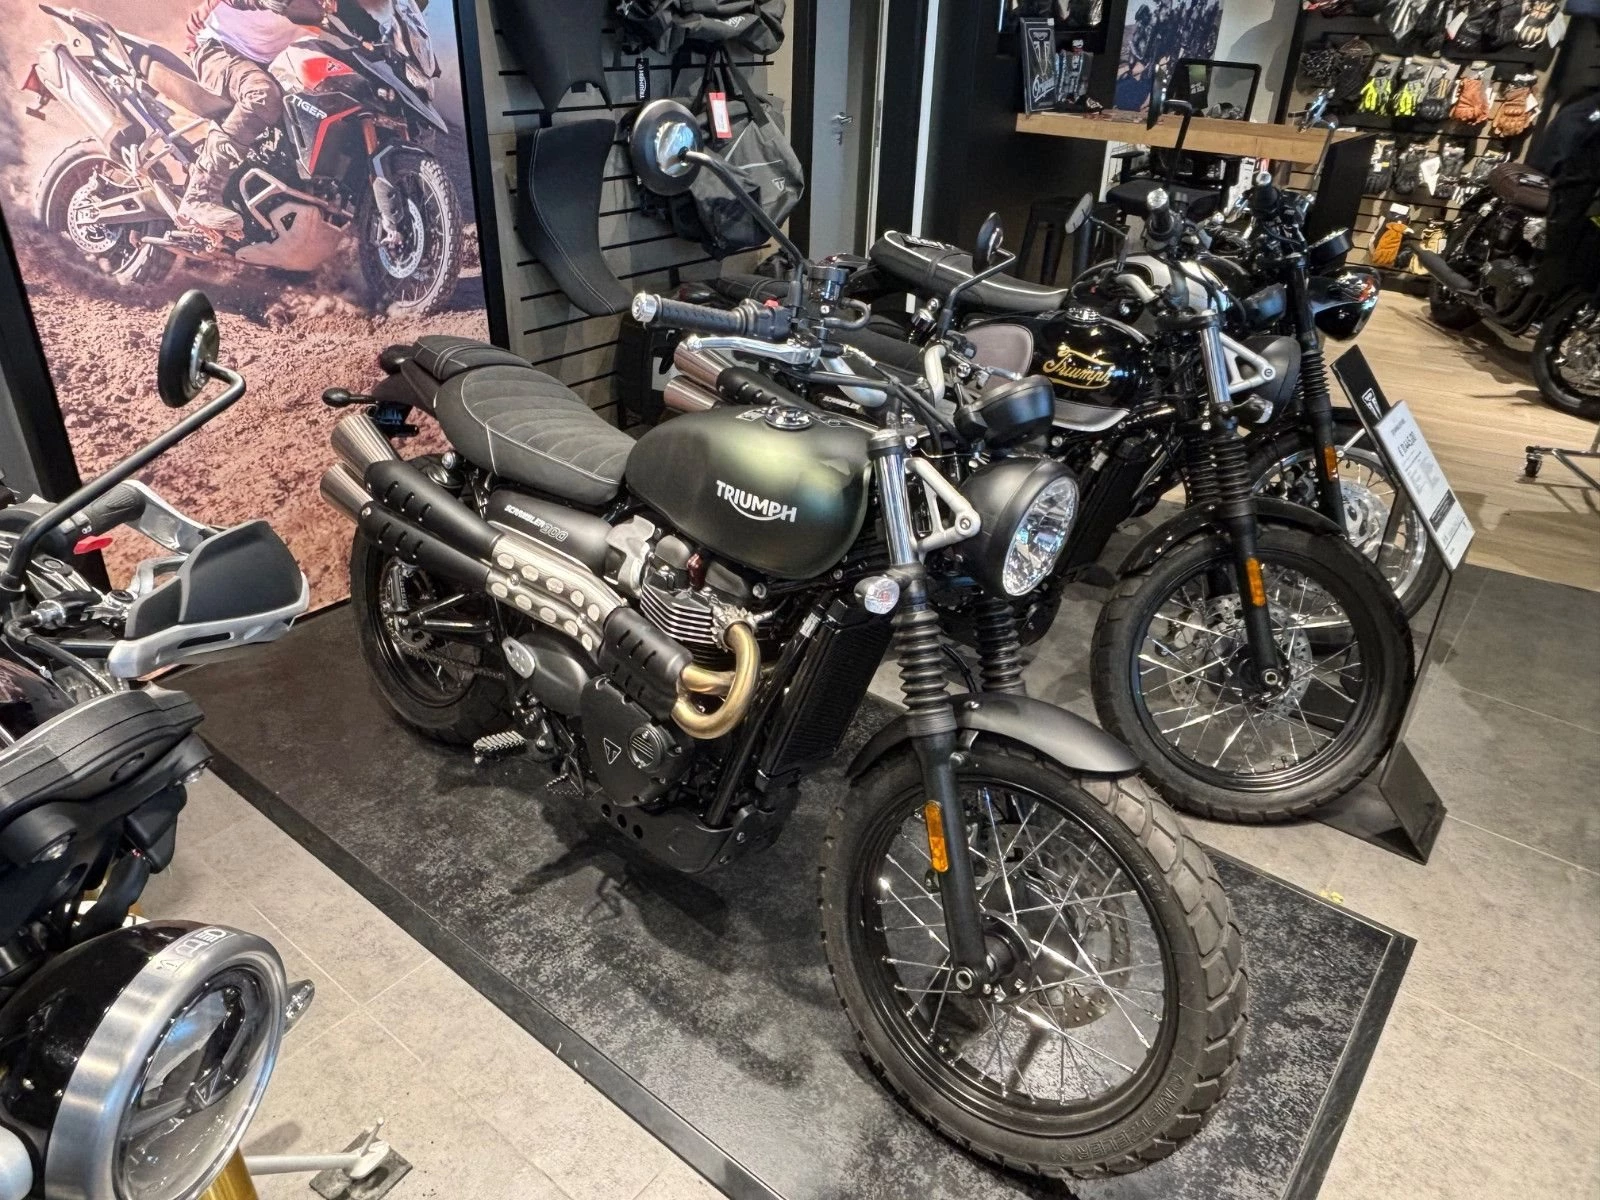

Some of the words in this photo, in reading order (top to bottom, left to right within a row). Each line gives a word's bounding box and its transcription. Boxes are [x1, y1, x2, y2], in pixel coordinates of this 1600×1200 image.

[291, 94, 328, 120] TIGER
[1042, 342, 1116, 390] Triumph
[716, 479, 798, 523] TRIUMPH
[540, 522, 569, 542] 900
